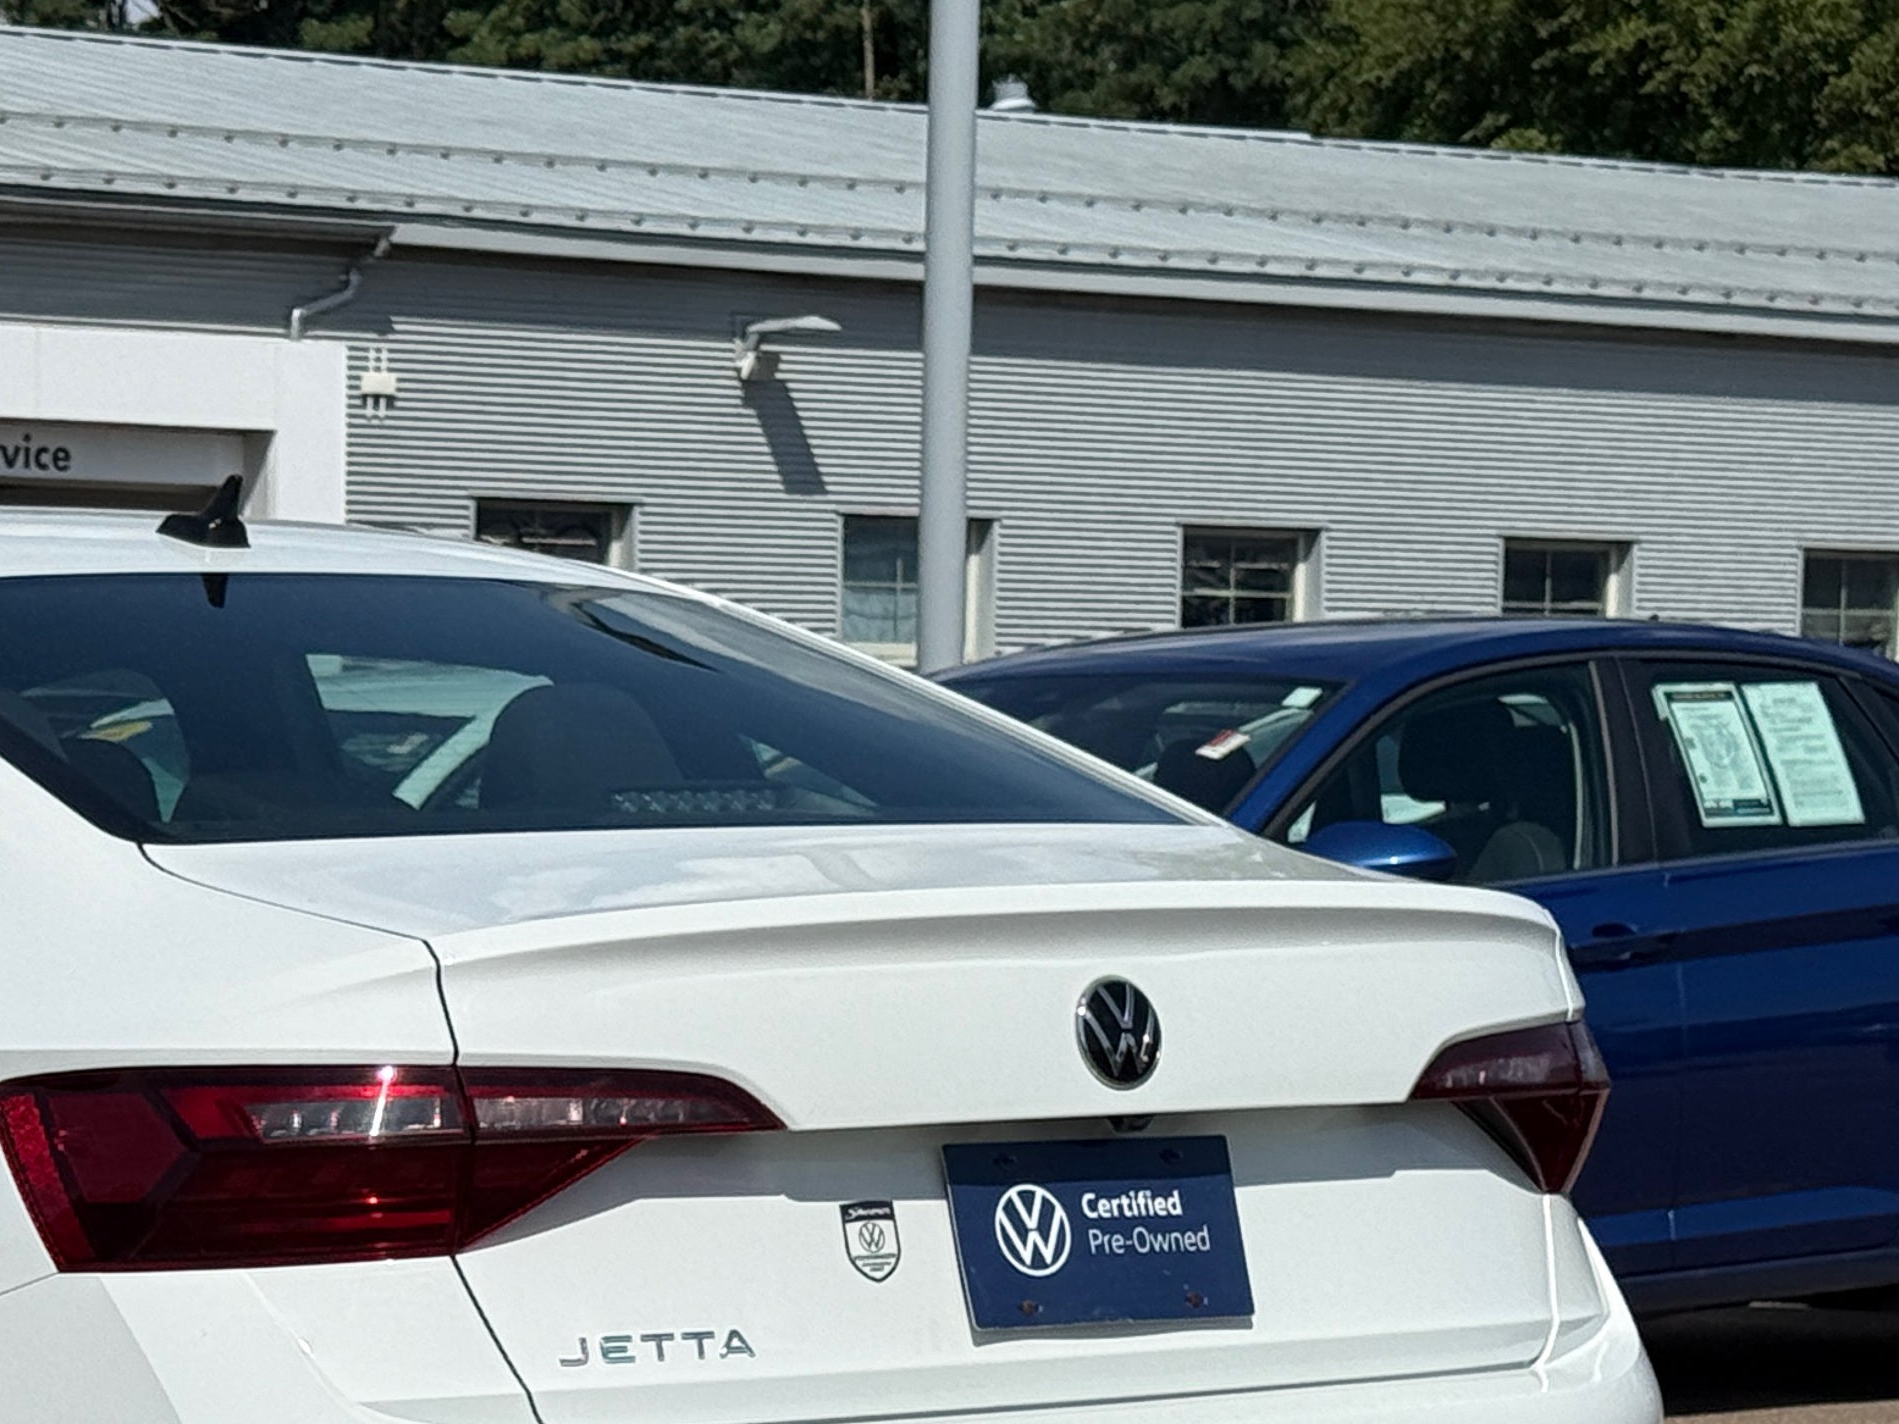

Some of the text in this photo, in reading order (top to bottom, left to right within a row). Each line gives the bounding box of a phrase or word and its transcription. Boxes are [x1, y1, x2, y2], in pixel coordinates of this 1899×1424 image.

[1081, 1190, 1183, 1218] Certified
[997, 1186, 1069, 1273] VW
[1088, 1224, 1211, 1254] Pre-Owned
[559, 1329, 756, 1367] JETTA
